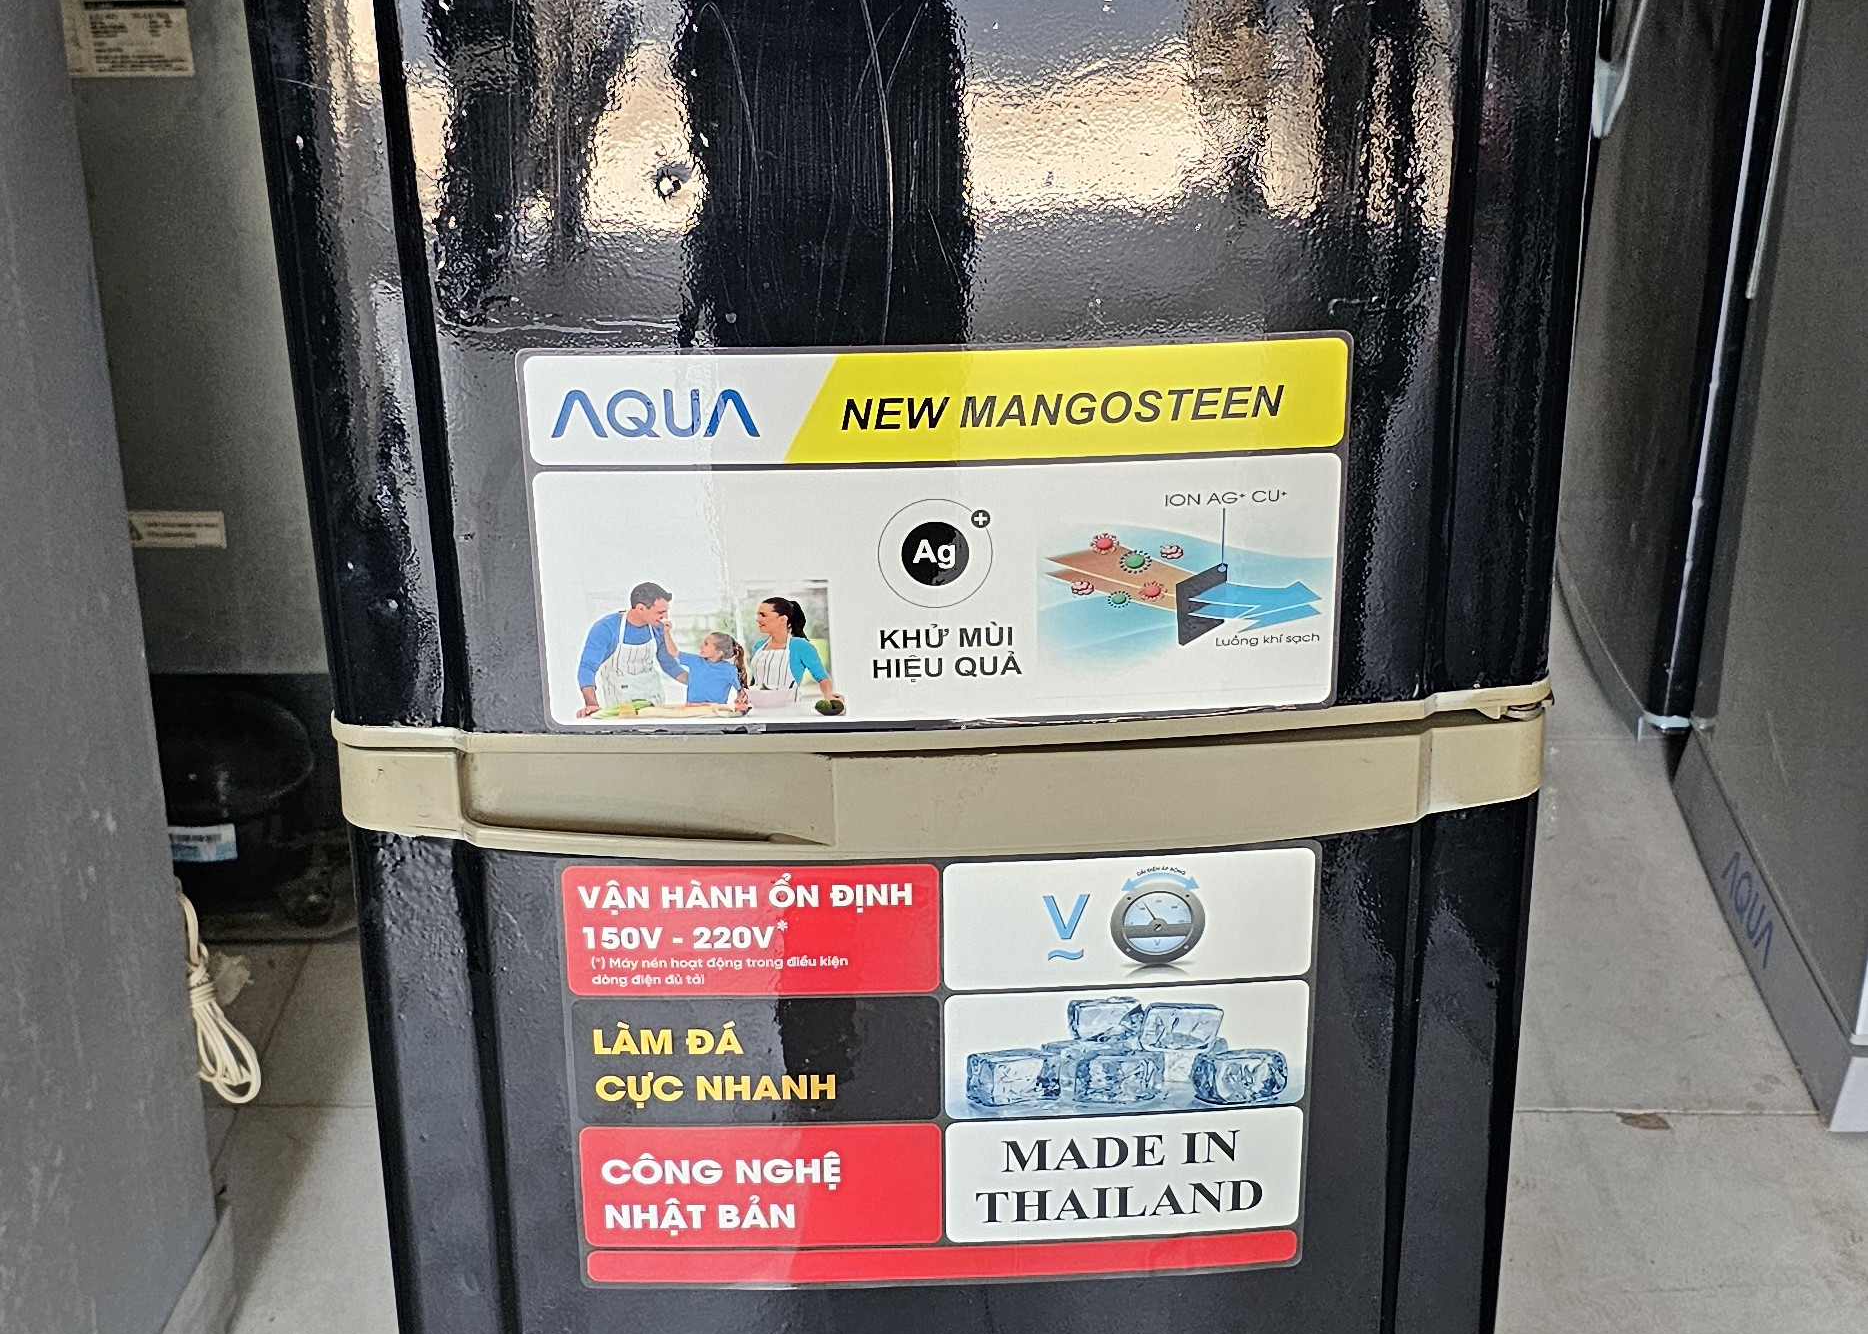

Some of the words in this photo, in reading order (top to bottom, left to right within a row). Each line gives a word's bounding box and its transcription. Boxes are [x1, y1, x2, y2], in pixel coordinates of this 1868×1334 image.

[551, 388, 761, 438] AQUA
[841, 396, 951, 431] NEW
[958, 384, 1285, 428] MANGOSTEEN
[1164, 493, 1201, 507] ION
[912, 539, 956, 569] Ag
[879, 623, 949, 650] KHỬ
[959, 620, 1013, 648] MÙI
[1263, 633, 1284, 644] khí
[1286, 632, 1320, 645] sạch
[872, 654, 943, 683] HIỆU
[954, 650, 1023, 677] QUẢ
[578, 879, 649, 916] VẬN
[661, 878, 757, 910] HÀNH
[768, 872, 819, 909] ỔN
[829, 882, 913, 915] ĐỊNH
[1721, 851, 1773, 970] AQUA
[1043, 894, 1091, 940] V
[582, 926, 663, 950] 150V
[609, 957, 639, 971] Máy
[670, 957, 704, 971] hoạt
[706, 957, 742, 971] động
[745, 957, 784, 970] trong
[593, 1021, 674, 1055] LÀM
[685, 1020, 744, 1055] ĐÁ
[595, 1071, 684, 1109] CỰC
[696, 1074, 837, 1101] NHANH
[601, 1152, 724, 1186] CÔNG
[735, 1150, 842, 1191] NGHỆ
[1001, 1135, 1166, 1173] MADE
[1181, 1129, 1241, 1166] IN
[604, 1197, 707, 1237] NHẬT
[717, 1194, 796, 1230] BẢN
[975, 1179, 1263, 1224] THAILAND
